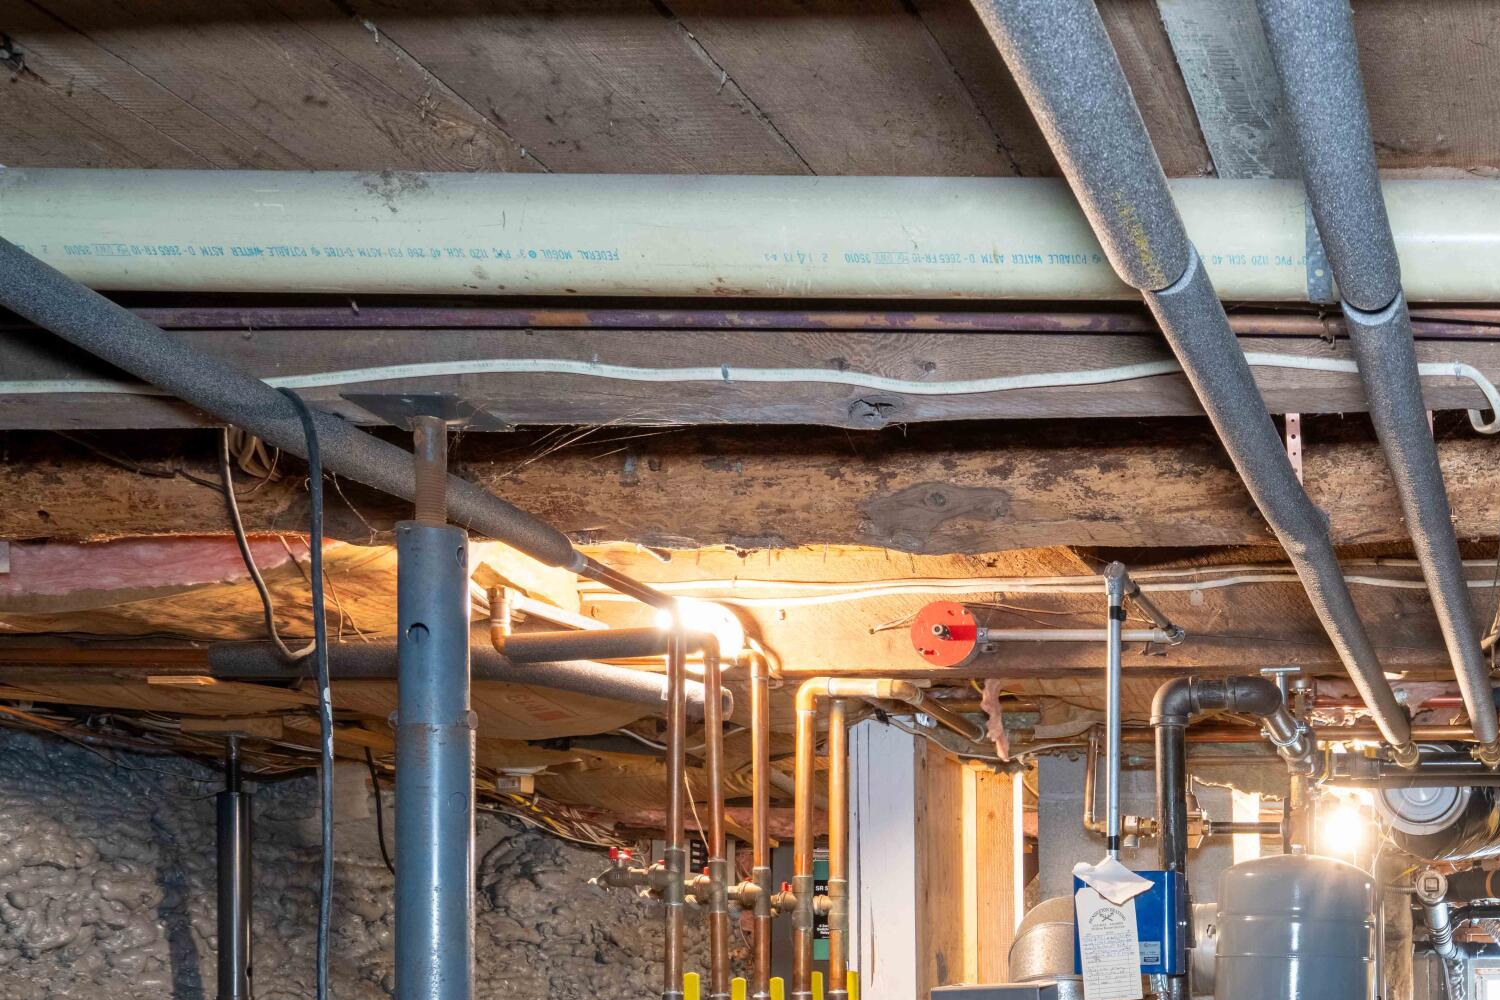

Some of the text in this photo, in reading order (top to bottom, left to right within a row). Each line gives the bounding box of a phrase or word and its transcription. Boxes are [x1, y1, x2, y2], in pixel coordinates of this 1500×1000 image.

[200, 246, 225, 257] ASTM
[231, 247, 260, 257] WATER
[357, 248, 383, 258] ASTM
[431, 248, 441, 258] 40
[540, 249, 574, 261] MOGUL
[578, 248, 619, 261] FEDERAL
[844, 253, 872, 264] 35010
[980, 253, 1005, 265] ASTM
[1011, 253, 1043, 265] WATER
[1212, 255, 1224, 266] 40
[1251, 255, 1269, 266] 1120
[1274, 255, 1292, 266] PVC
